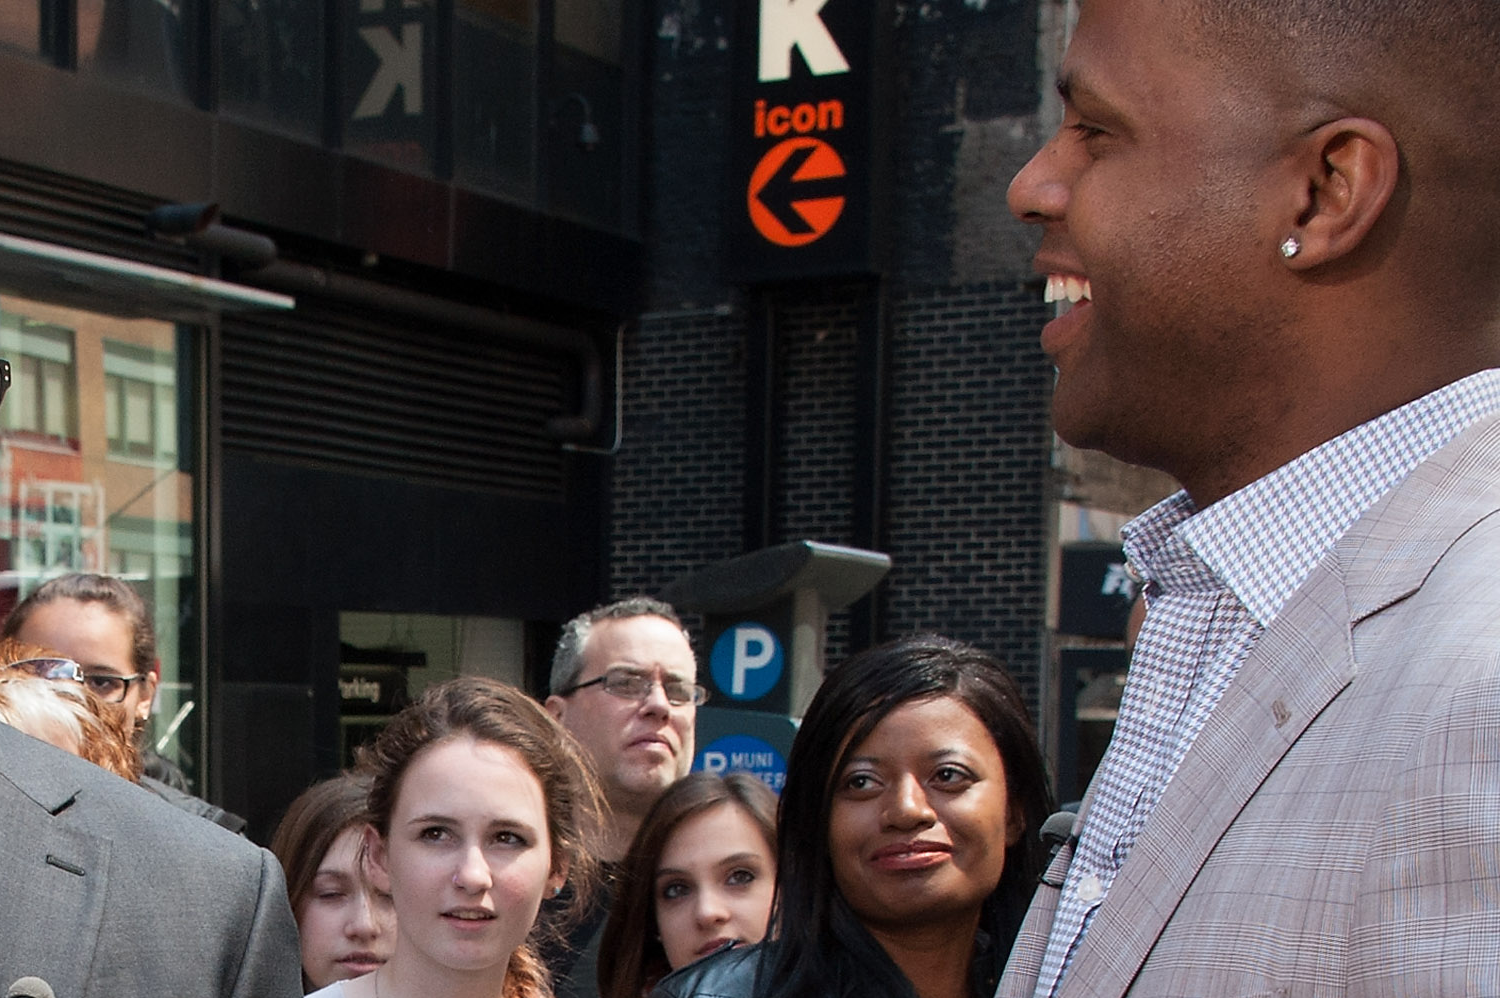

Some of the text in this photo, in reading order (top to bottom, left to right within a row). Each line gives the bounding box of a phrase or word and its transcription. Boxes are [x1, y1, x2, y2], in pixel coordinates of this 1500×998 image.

[758, 0, 850, 83] K
[754, 99, 844, 138] icon
[731, 627, 775, 696] P
[731, 752, 773, 768] MUNI
